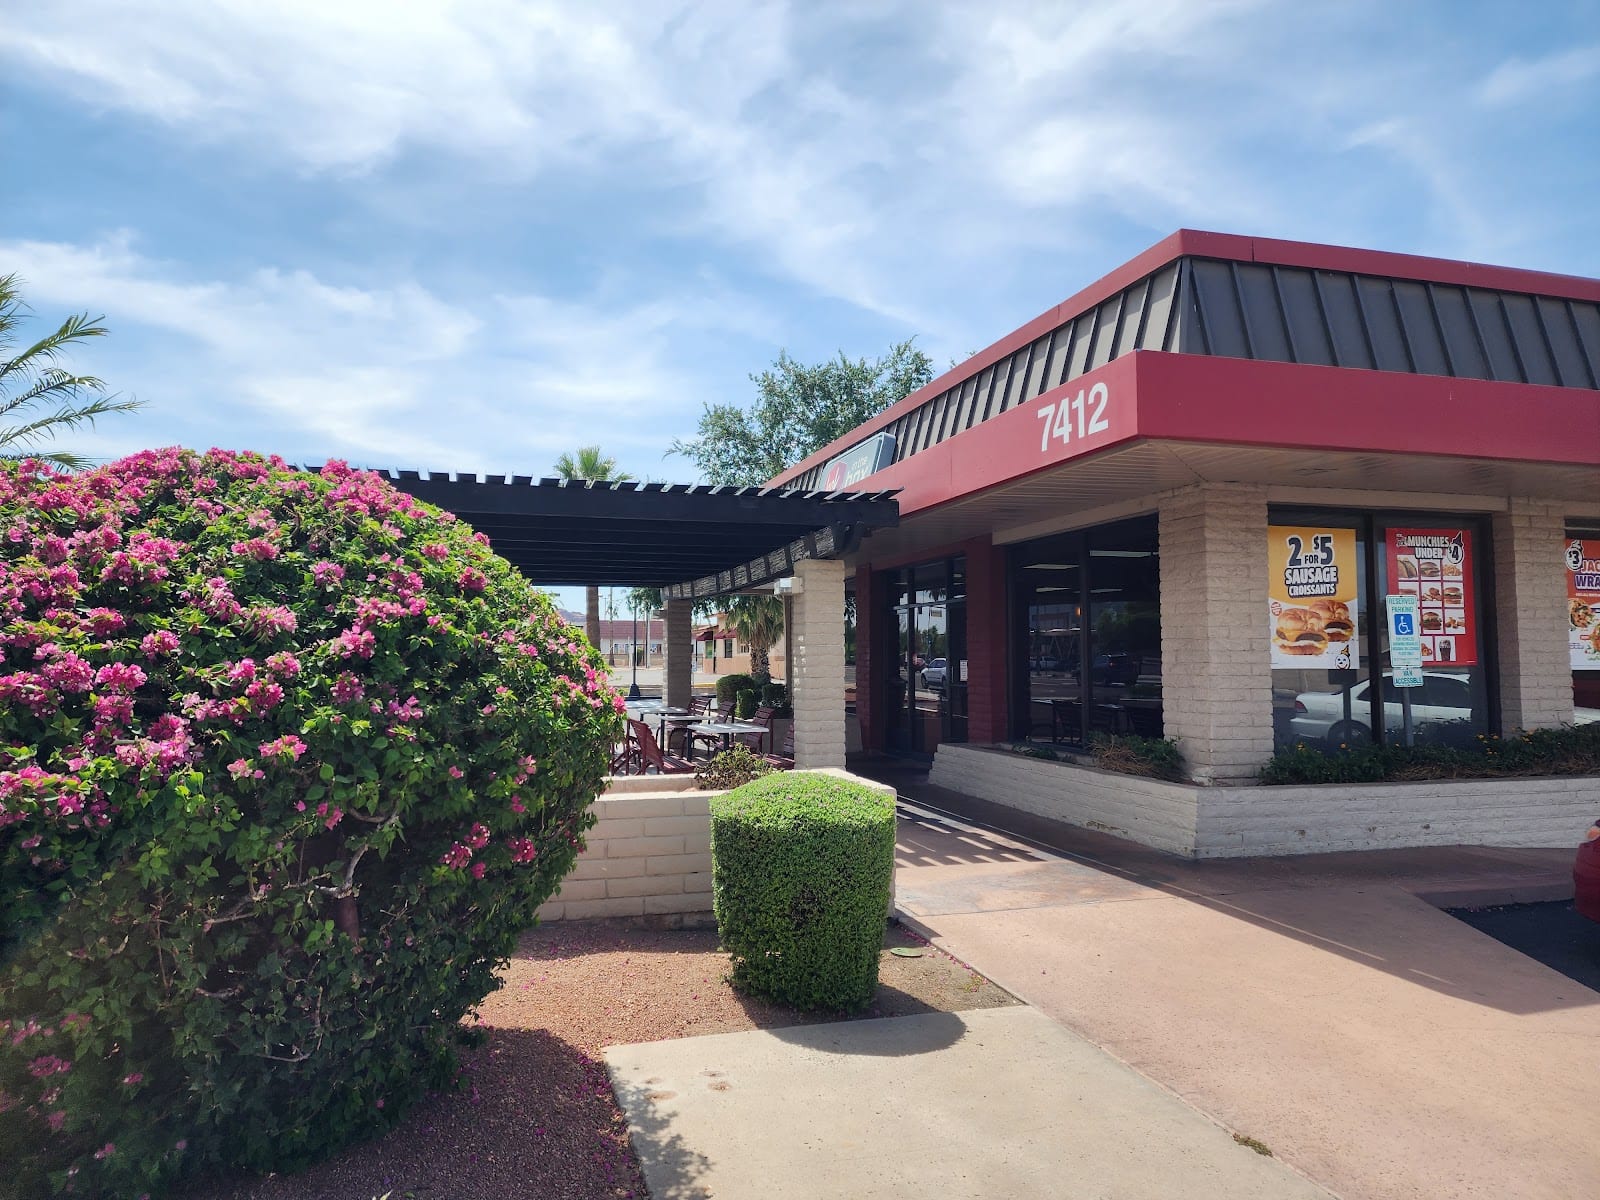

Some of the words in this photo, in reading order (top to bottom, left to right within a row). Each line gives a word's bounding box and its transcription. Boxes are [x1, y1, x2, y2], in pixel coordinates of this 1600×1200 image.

[1037, 382, 1109, 453] 7412
[1407, 535, 1450, 548] MUNCHIES
[1287, 536, 1302, 567] 2
[1304, 554, 1319, 564] FOR
[1313, 535, 1334, 566] $5
[1415, 547, 1443, 559] UNDER
[1448, 545, 1460, 561] $4
[1568, 550, 1580, 565] $3
[1285, 566, 1337, 585] SAUSAGE
[1288, 583, 1336, 596] CROISSANTS
[1395, 677, 1422, 685] ACCESSIBLE
